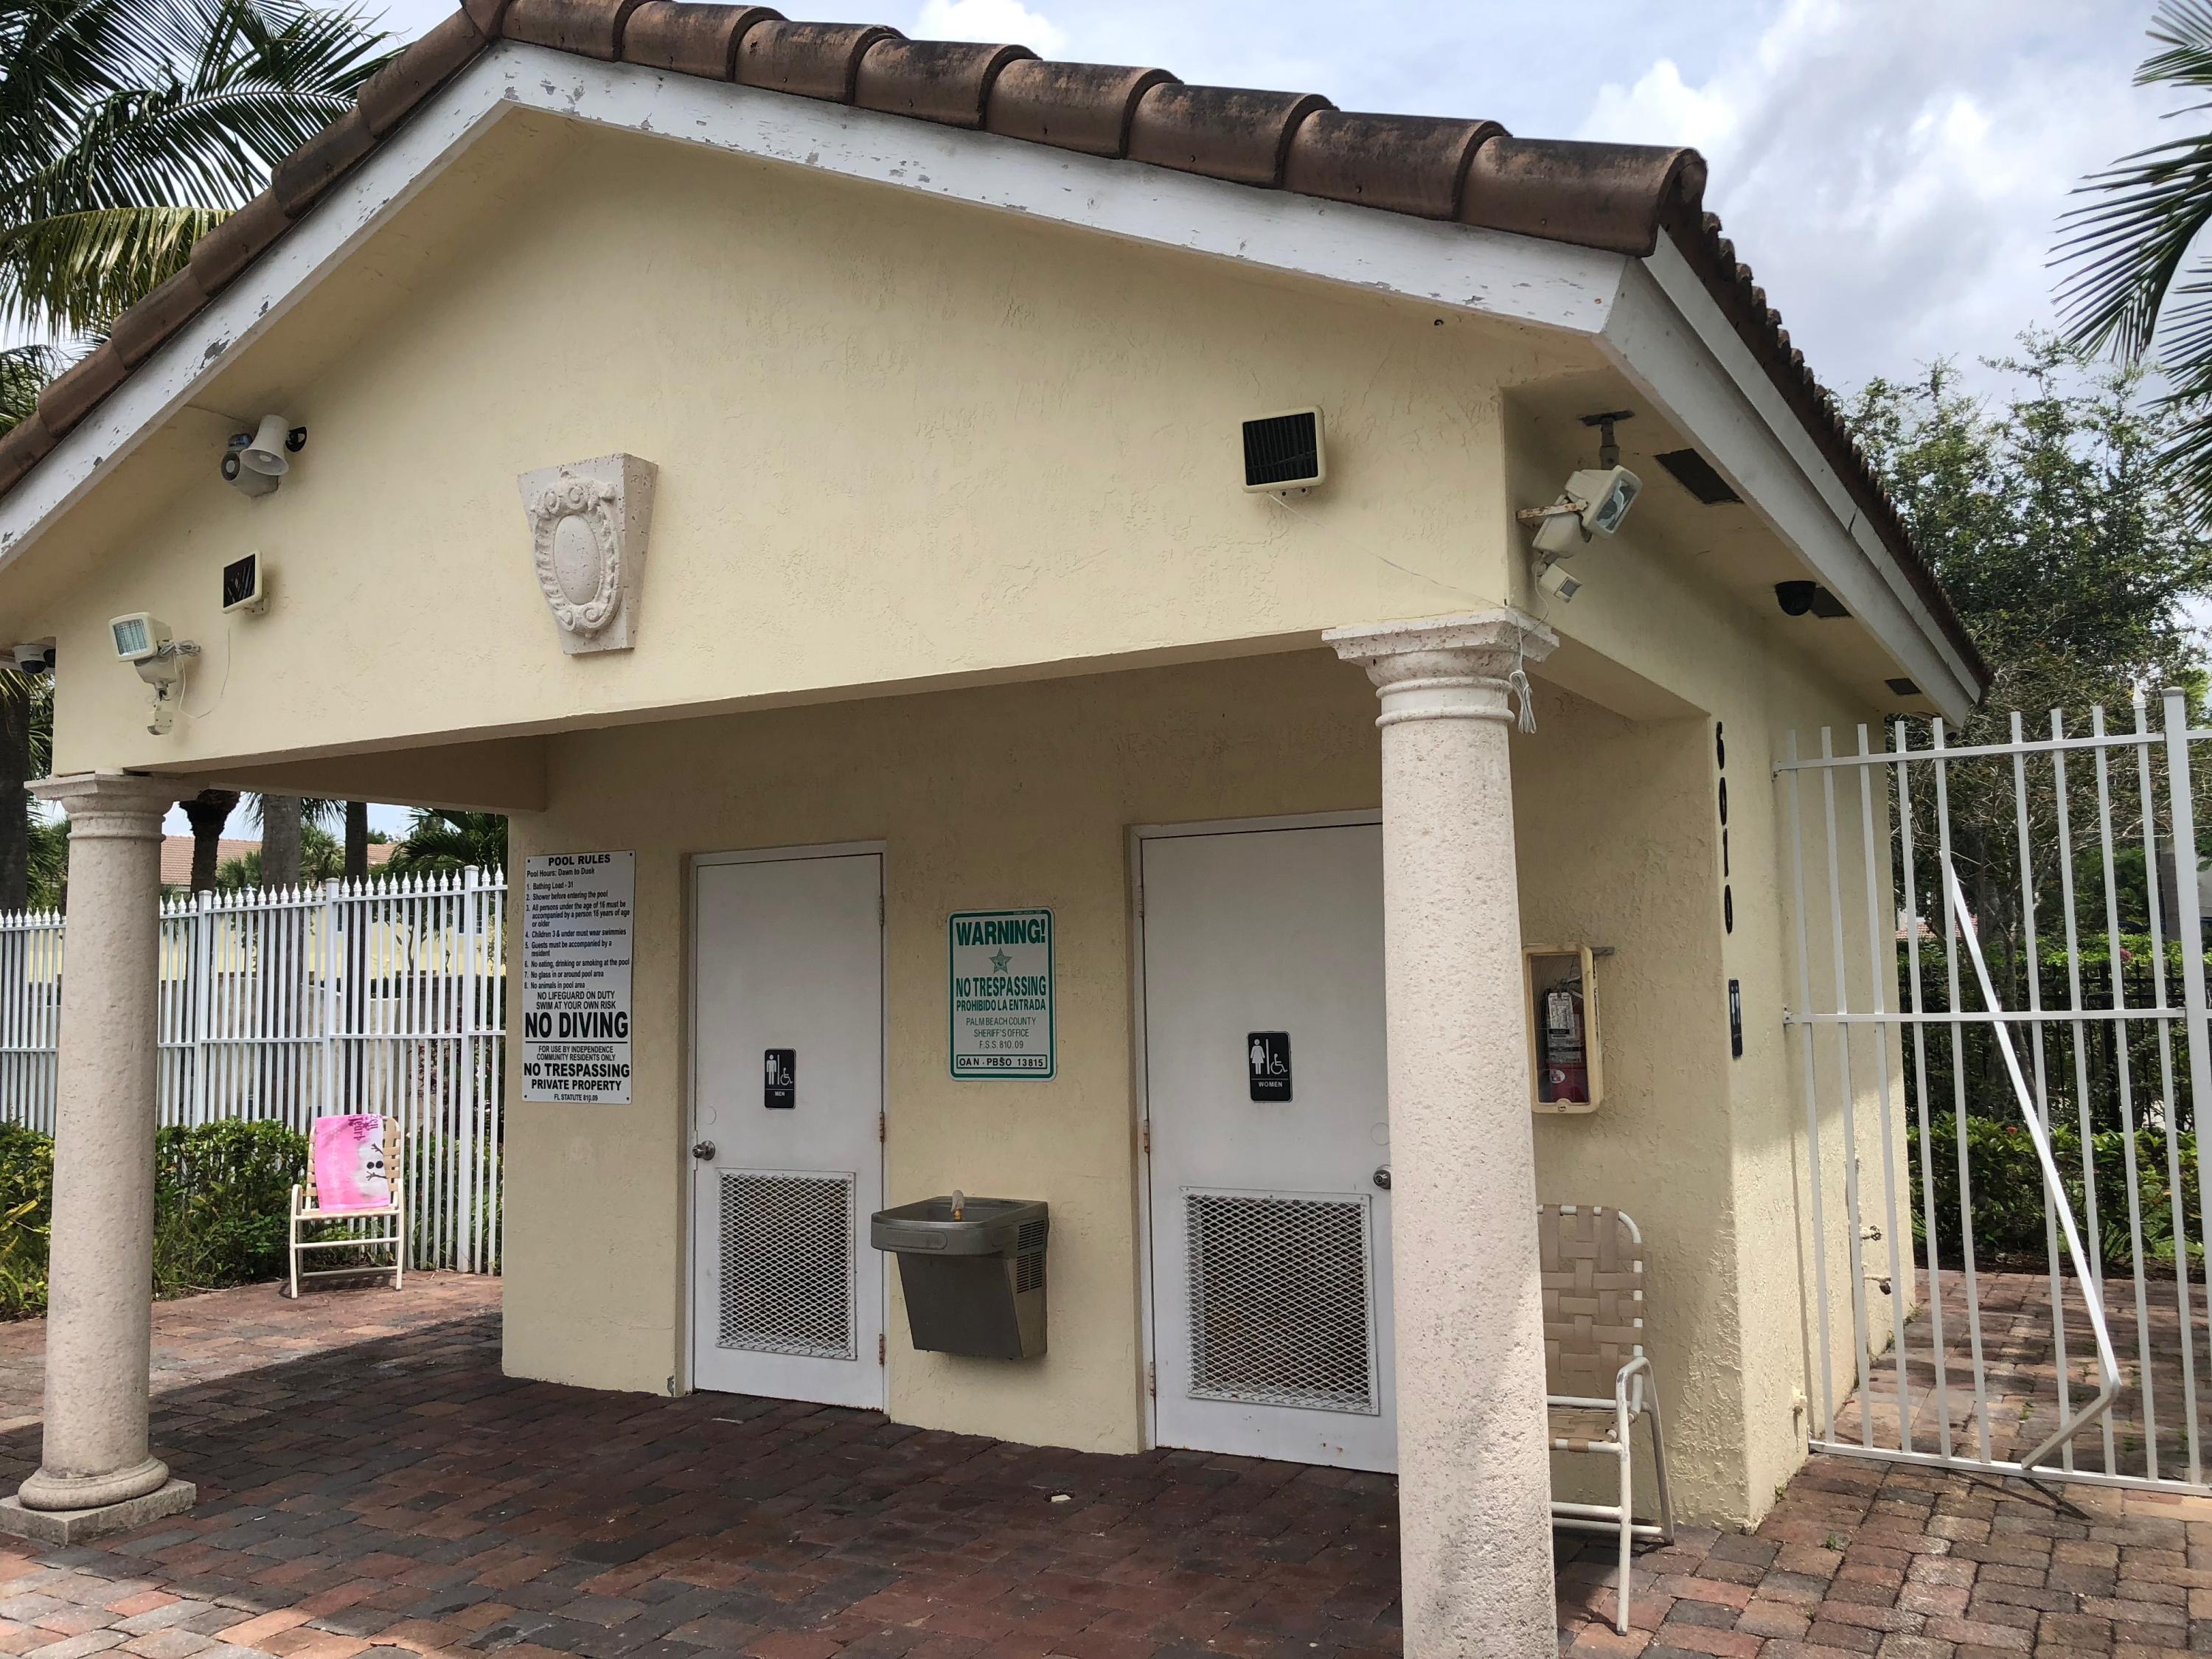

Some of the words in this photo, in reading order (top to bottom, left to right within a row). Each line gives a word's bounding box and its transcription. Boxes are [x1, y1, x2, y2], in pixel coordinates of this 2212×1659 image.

[549, 856, 574, 866] POOL
[578, 854, 611, 864] RULES
[581, 866, 594, 874] Dusk
[533, 882, 551, 891] Bathing
[552, 881, 564, 889] Load
[568, 880, 574, 888] 31
[567, 891, 587, 900] entering
[597, 889, 608, 899] pool
[540, 904, 558, 913] persons
[583, 902, 592, 911] age
[620, 900, 626, 908] be
[532, 911, 563, 920] accompanied
[564, 911, 570, 919] by
[575, 910, 592, 919] person
[600, 910, 613, 919] years
[614, 908, 620, 916] of
[621, 910, 630, 918] age
[532, 930, 551, 938] Children
[602, 928, 627, 936] swimmies
[956, 919, 1046, 945] WARNING!
[532, 941, 548, 949] Guests
[568, 939, 601, 949] accompanied
[602, 939, 608, 948] by
[555, 959, 575, 968] drinking
[582, 959, 603, 968] smoking
[619, 958, 630, 967] pool
[531, 970, 538, 978] No
[538, 970, 552, 980] glass
[564, 970, 581, 978] around
[581, 970, 593, 979] pool
[531, 981, 538, 990] No
[538, 981, 557, 989] animals
[563, 981, 574, 990] pool
[956, 977, 971, 998] NO
[973, 975, 1046, 997] TRESPASSING
[538, 992, 547, 1000] NO
[549, 991, 585, 1000] LIFEGUARD
[586, 991, 597, 1000] ON
[597, 991, 615, 999] DUTY
[536, 1001, 553, 1010] SWIM
[554, 1001, 563, 1009] AT
[564, 1001, 582, 1009] YOUR
[583, 1001, 599, 1009] OWN
[600, 1001, 616, 1009] RISK
[956, 999, 996, 1012] PROHIBIDO
[998, 999, 1008, 1011] LA
[1009, 998, 1046, 1011] ENTRADA
[525, 1012, 552, 1038] NO
[559, 1011, 628, 1038] DIVING
[966, 1018, 985, 1026] PALM
[985, 1017, 1008, 1026] BEACH
[1009, 1017, 1037, 1026] COUNTY
[973, 1029, 1006, 1037] SHERIFF'S
[1007, 1029, 1029, 1037] OFFICE
[571, 1046, 613, 1054] INDEPENDENCE
[959, 1057, 979, 1066] OAN
[987, 1057, 1012, 1066] PBSO
[1017, 1058, 1043, 1067] 13815
[524, 1062, 541, 1077] NO
[544, 1062, 630, 1078] TRESPASSING
[531, 1079, 569, 1090] PRIVATE
[572, 1079, 622, 1091] PROPERTY
